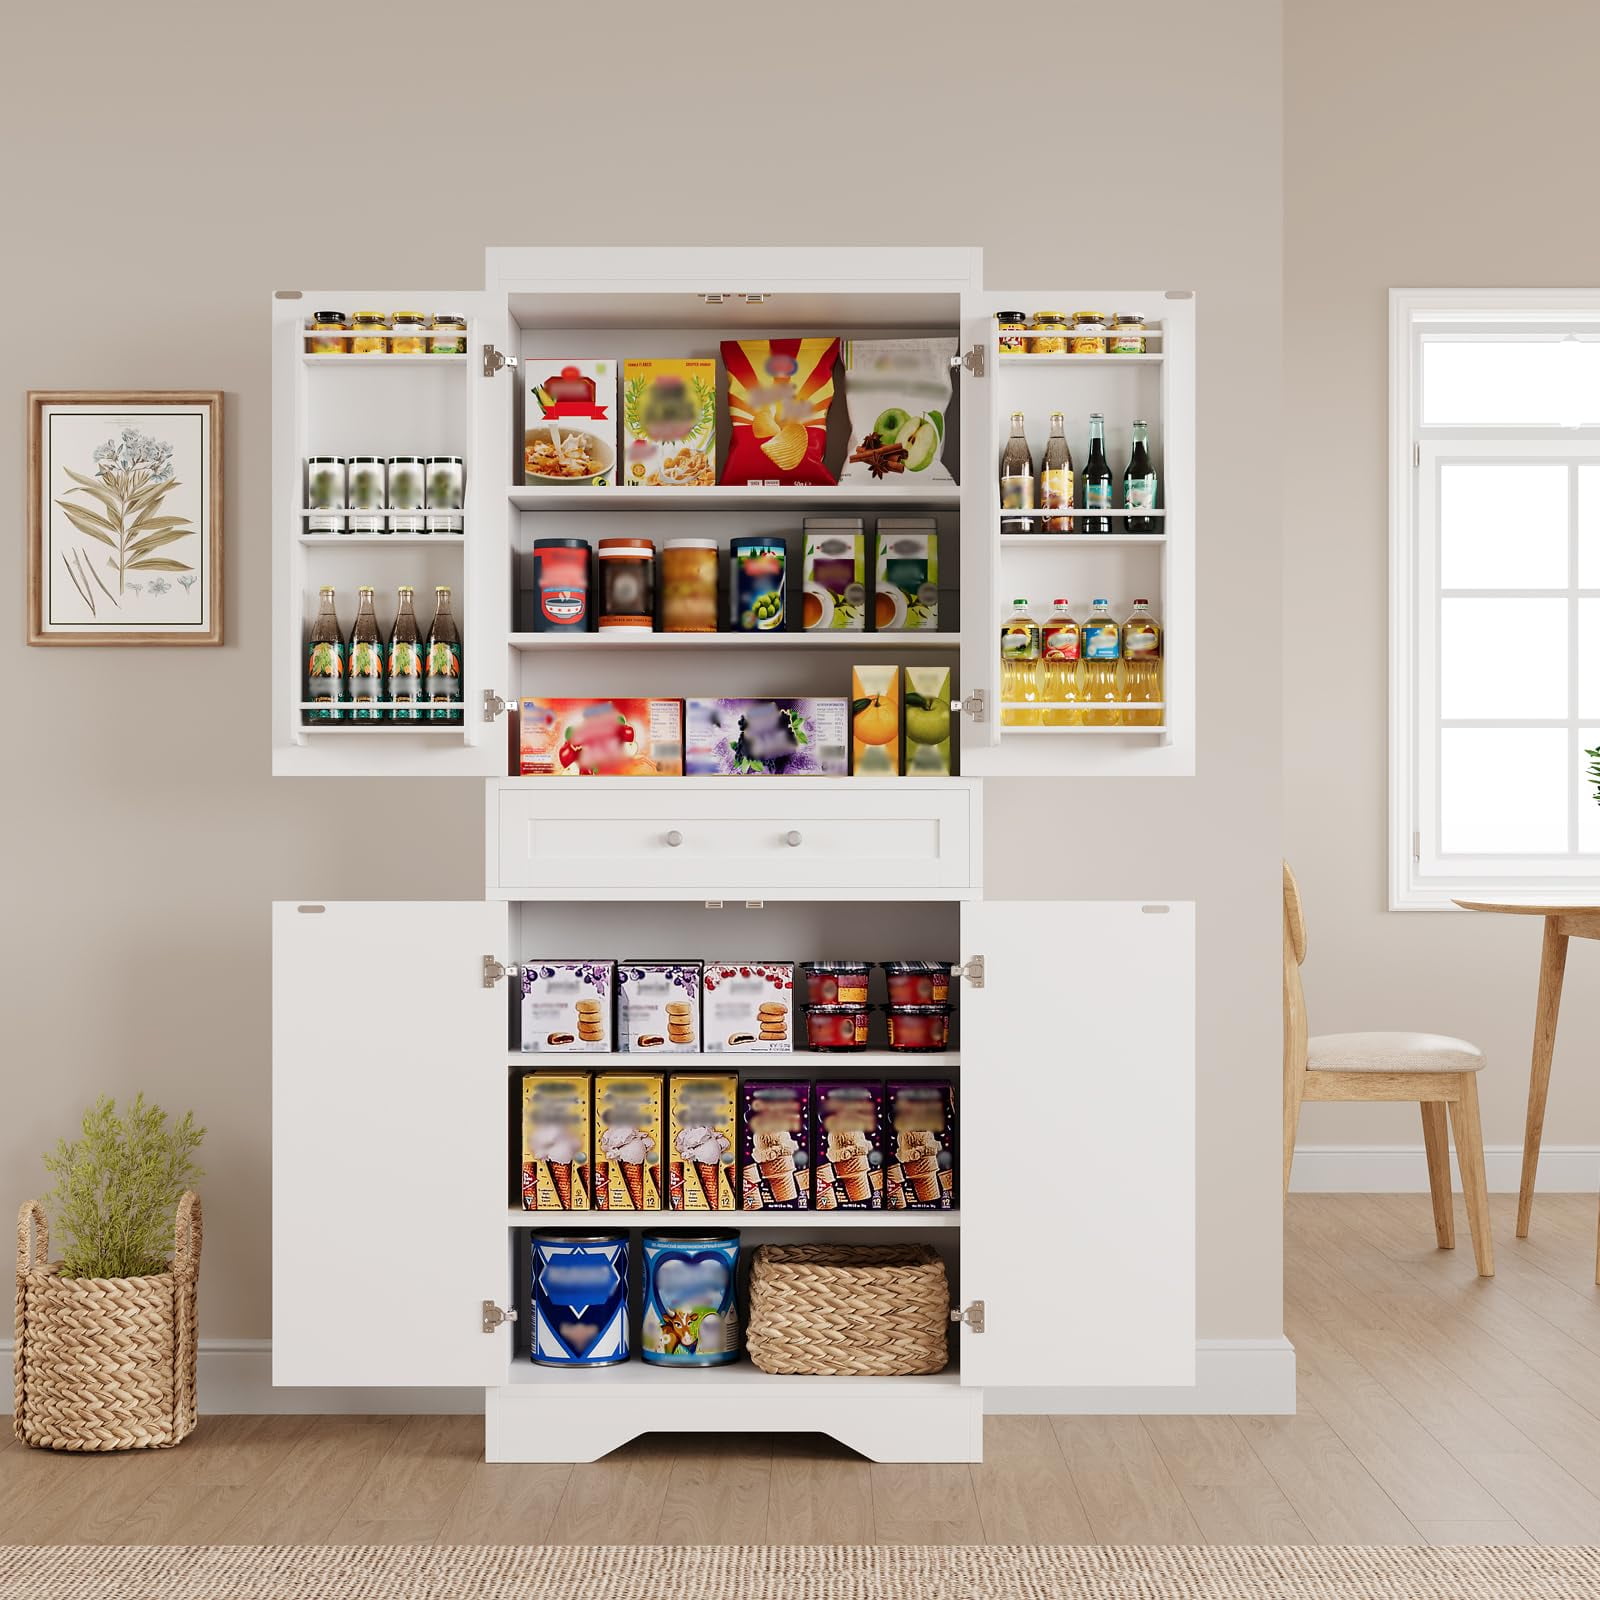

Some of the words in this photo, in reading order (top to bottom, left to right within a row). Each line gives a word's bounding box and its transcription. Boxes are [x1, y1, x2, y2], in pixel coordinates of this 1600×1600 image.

[575, 1197, 583, 1205] 12
[646, 1197, 655, 1205] 12
[721, 1197, 730, 1205] 12
[799, 1198, 807, 1206] 12
[873, 1198, 881, 1206] 12
[942, 1198, 951, 1206] 12
